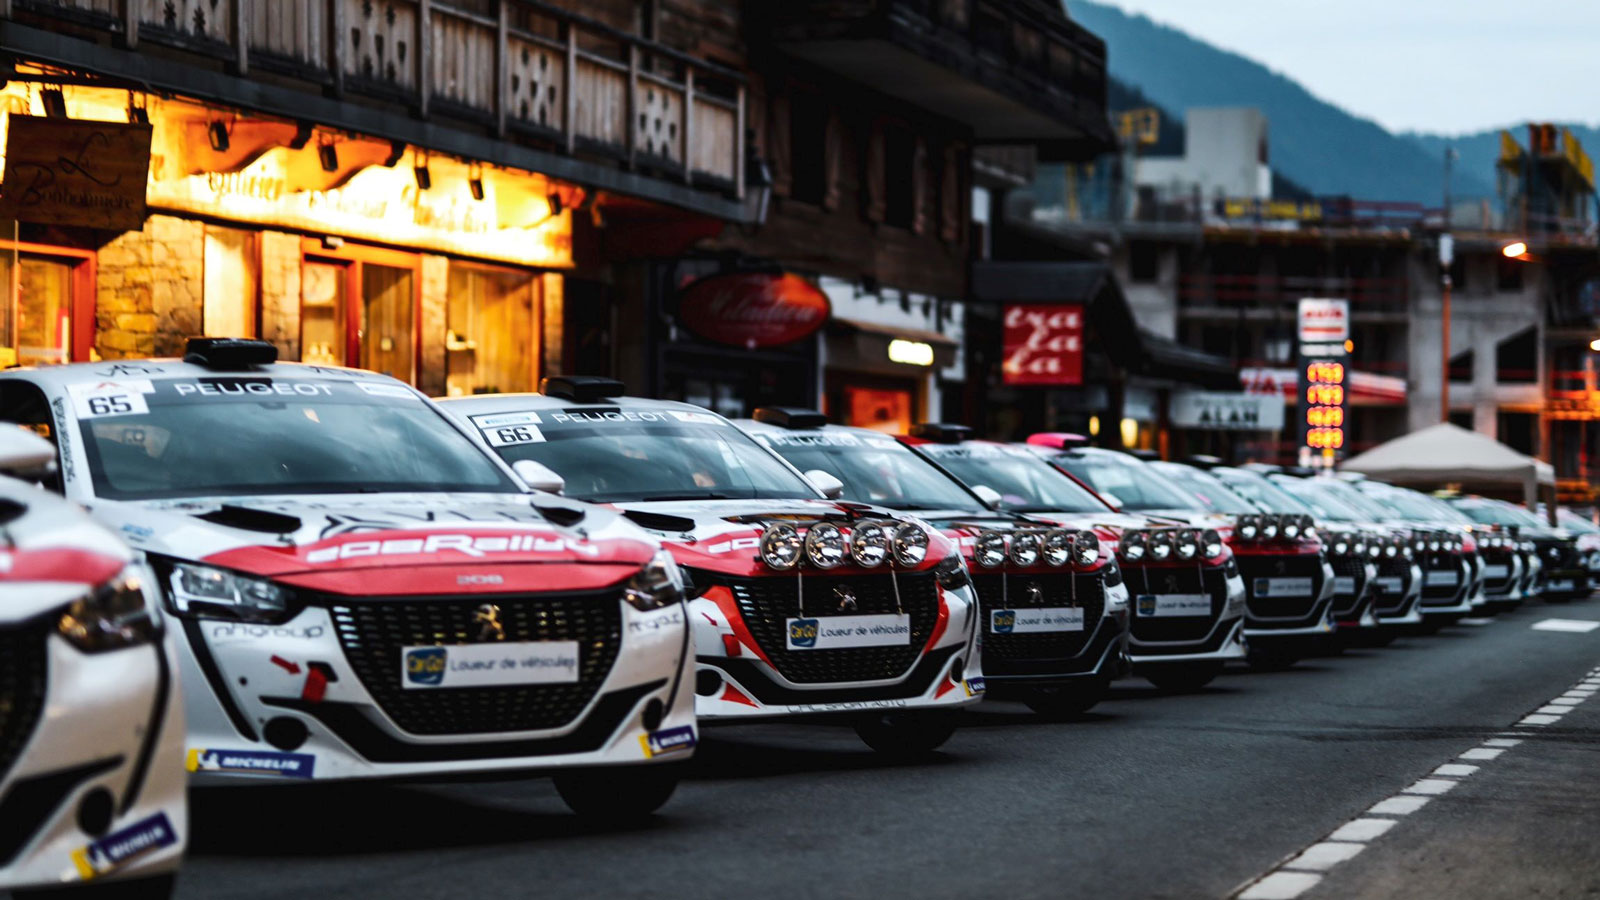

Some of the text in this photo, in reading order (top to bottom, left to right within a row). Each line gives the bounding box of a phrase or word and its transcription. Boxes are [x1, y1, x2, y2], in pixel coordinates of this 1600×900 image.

[174, 382, 333, 397] PEUGEOT
[88, 394, 132, 415] 65
[551, 411, 669, 424] PEUGEOT
[497, 426, 533, 443] 66
[820, 626, 854, 637] Loueur
[855, 624, 868, 636] de
[499, 656, 517, 670] de
[222, 756, 301, 770] MICHELIN
